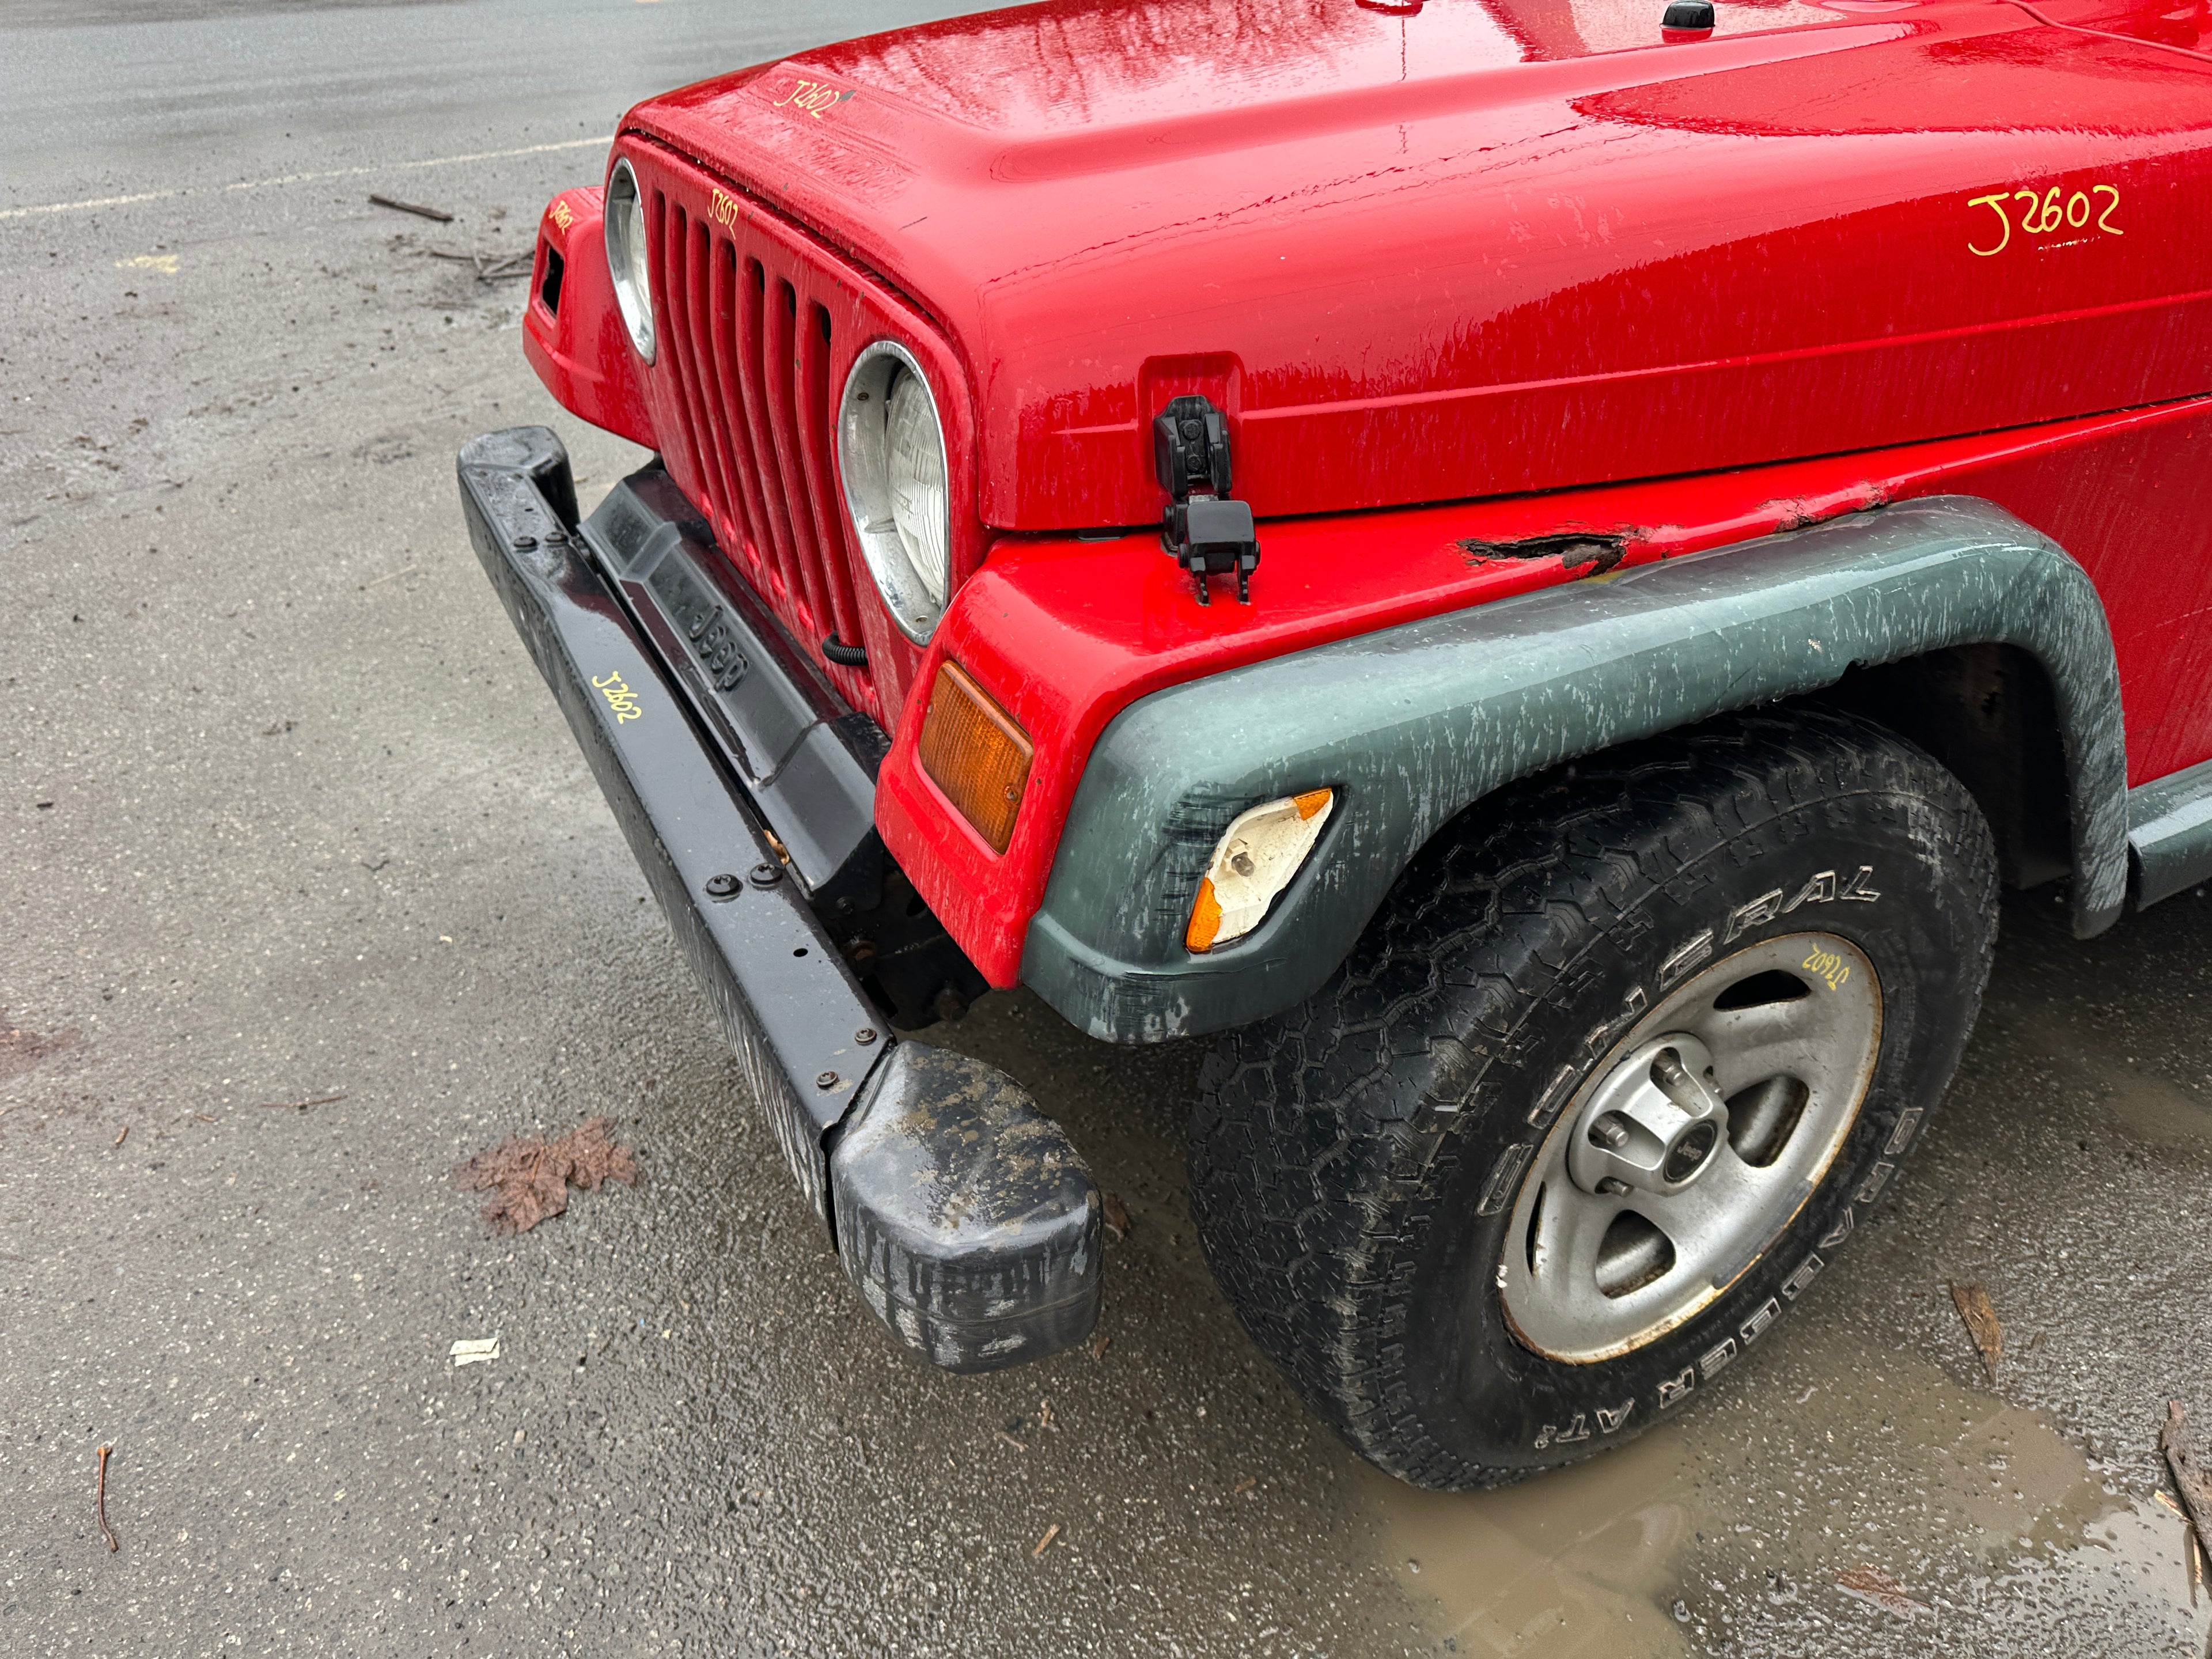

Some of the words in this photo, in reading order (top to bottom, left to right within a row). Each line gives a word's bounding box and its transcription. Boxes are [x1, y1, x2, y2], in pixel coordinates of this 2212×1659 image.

[773, 79, 840, 119] J2602
[707, 188, 738, 240] J2602
[1967, 185, 2124, 256] J2602
[690, 604, 749, 693] Jeep
[592, 671, 642, 725] J2602
[1477, 865, 1882, 1217] GENERAL
[1655, 1107, 1924, 1410] GRABBER
